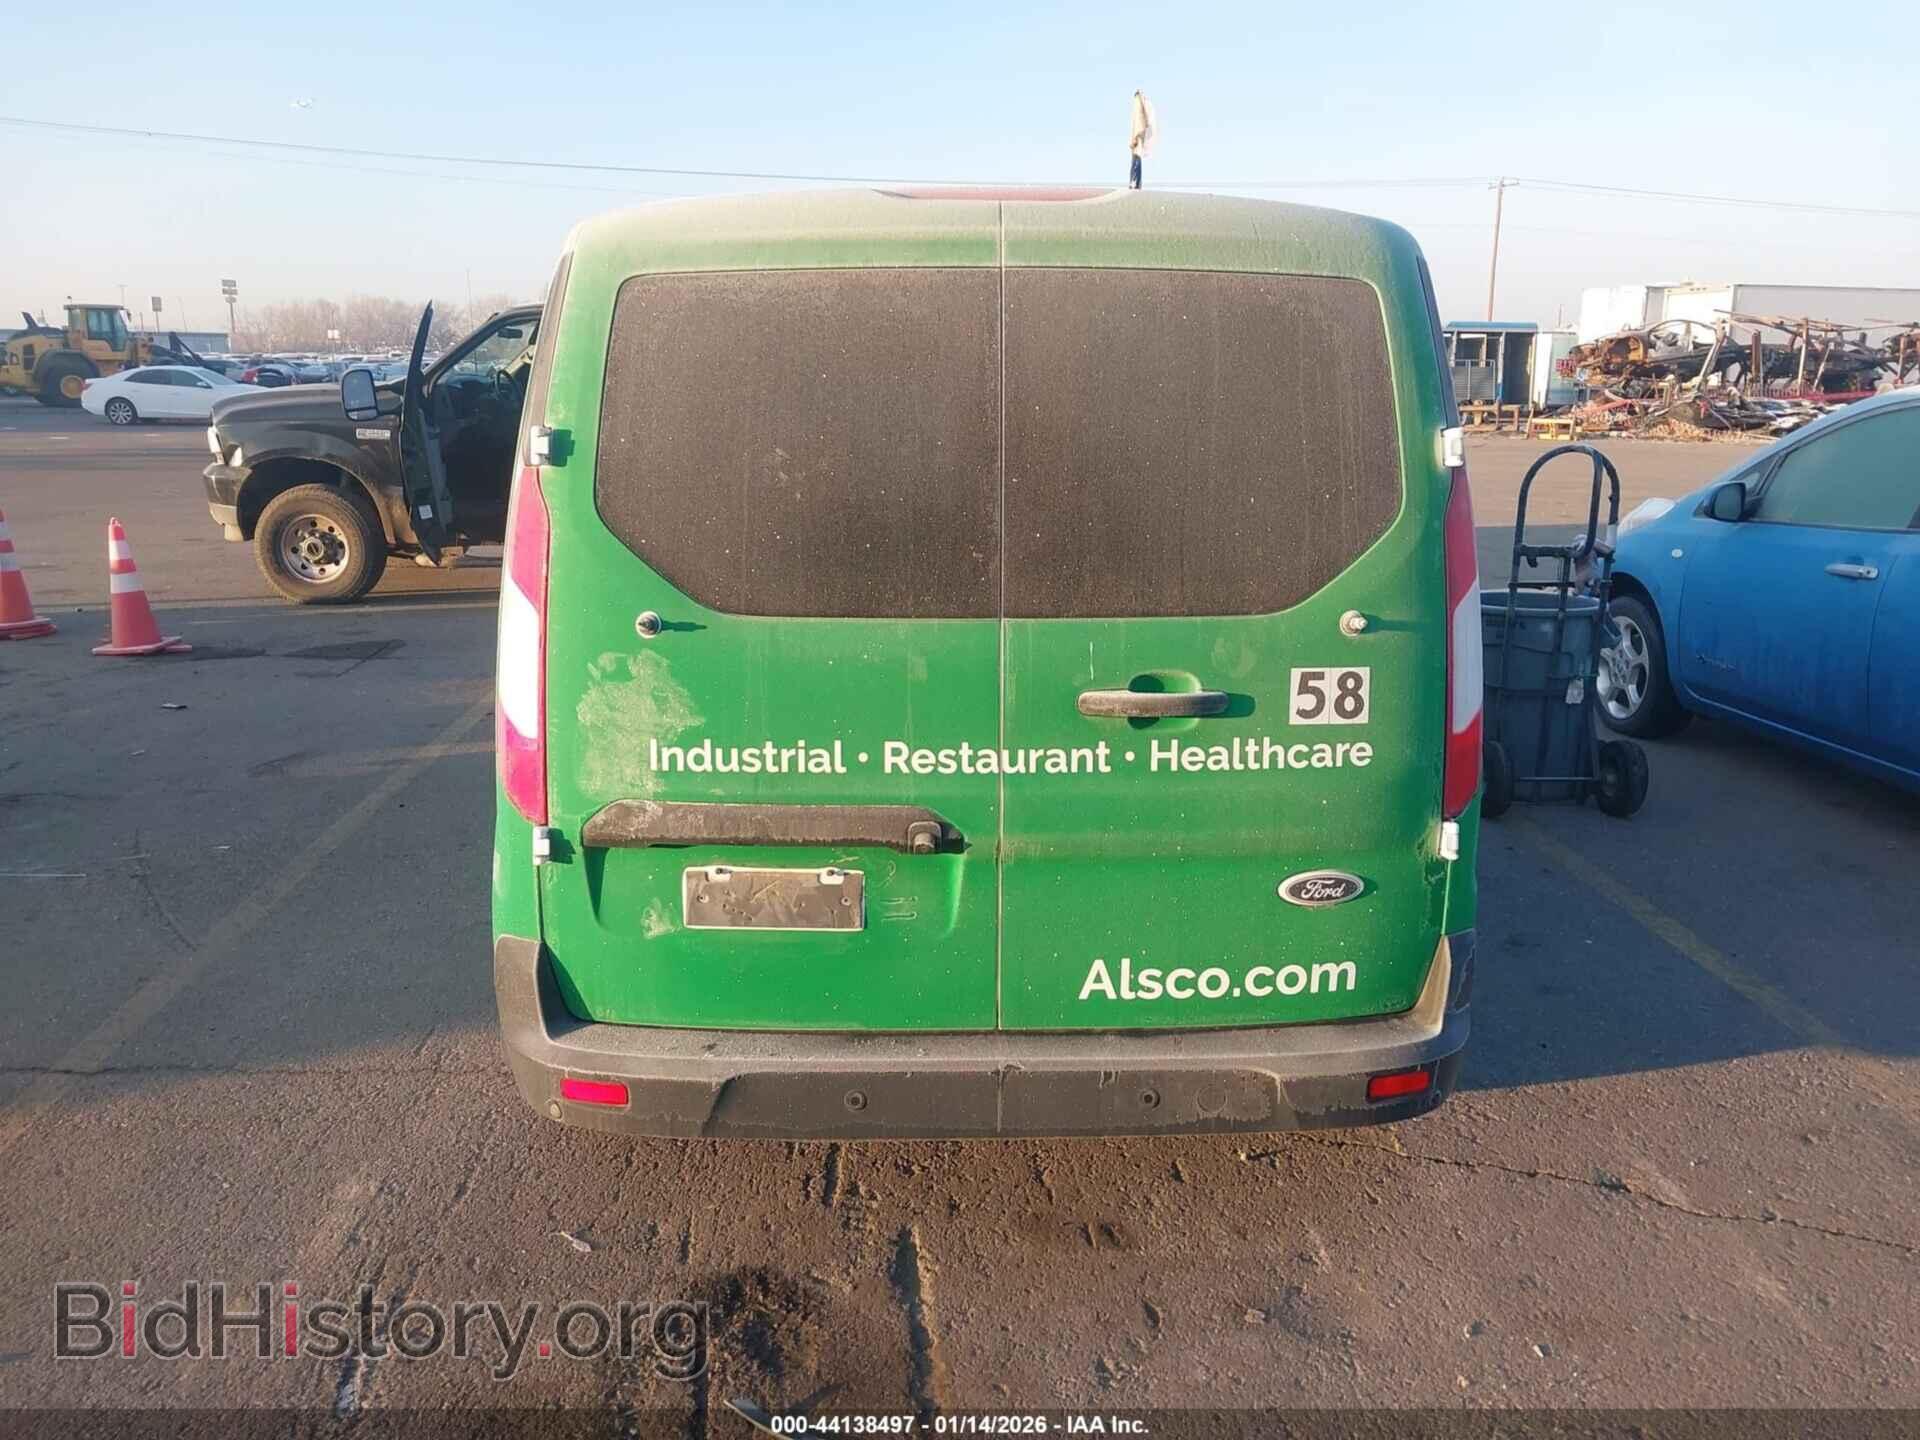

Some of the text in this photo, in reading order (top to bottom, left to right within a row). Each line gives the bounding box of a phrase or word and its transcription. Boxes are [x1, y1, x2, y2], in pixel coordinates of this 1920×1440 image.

[1296, 671, 1365, 719] 58
[650, 736, 1374, 774] Industrial Restaurant Healthcare
[1300, 878, 1345, 899] Ford
[1078, 957, 1357, 1000] Alsco.com
